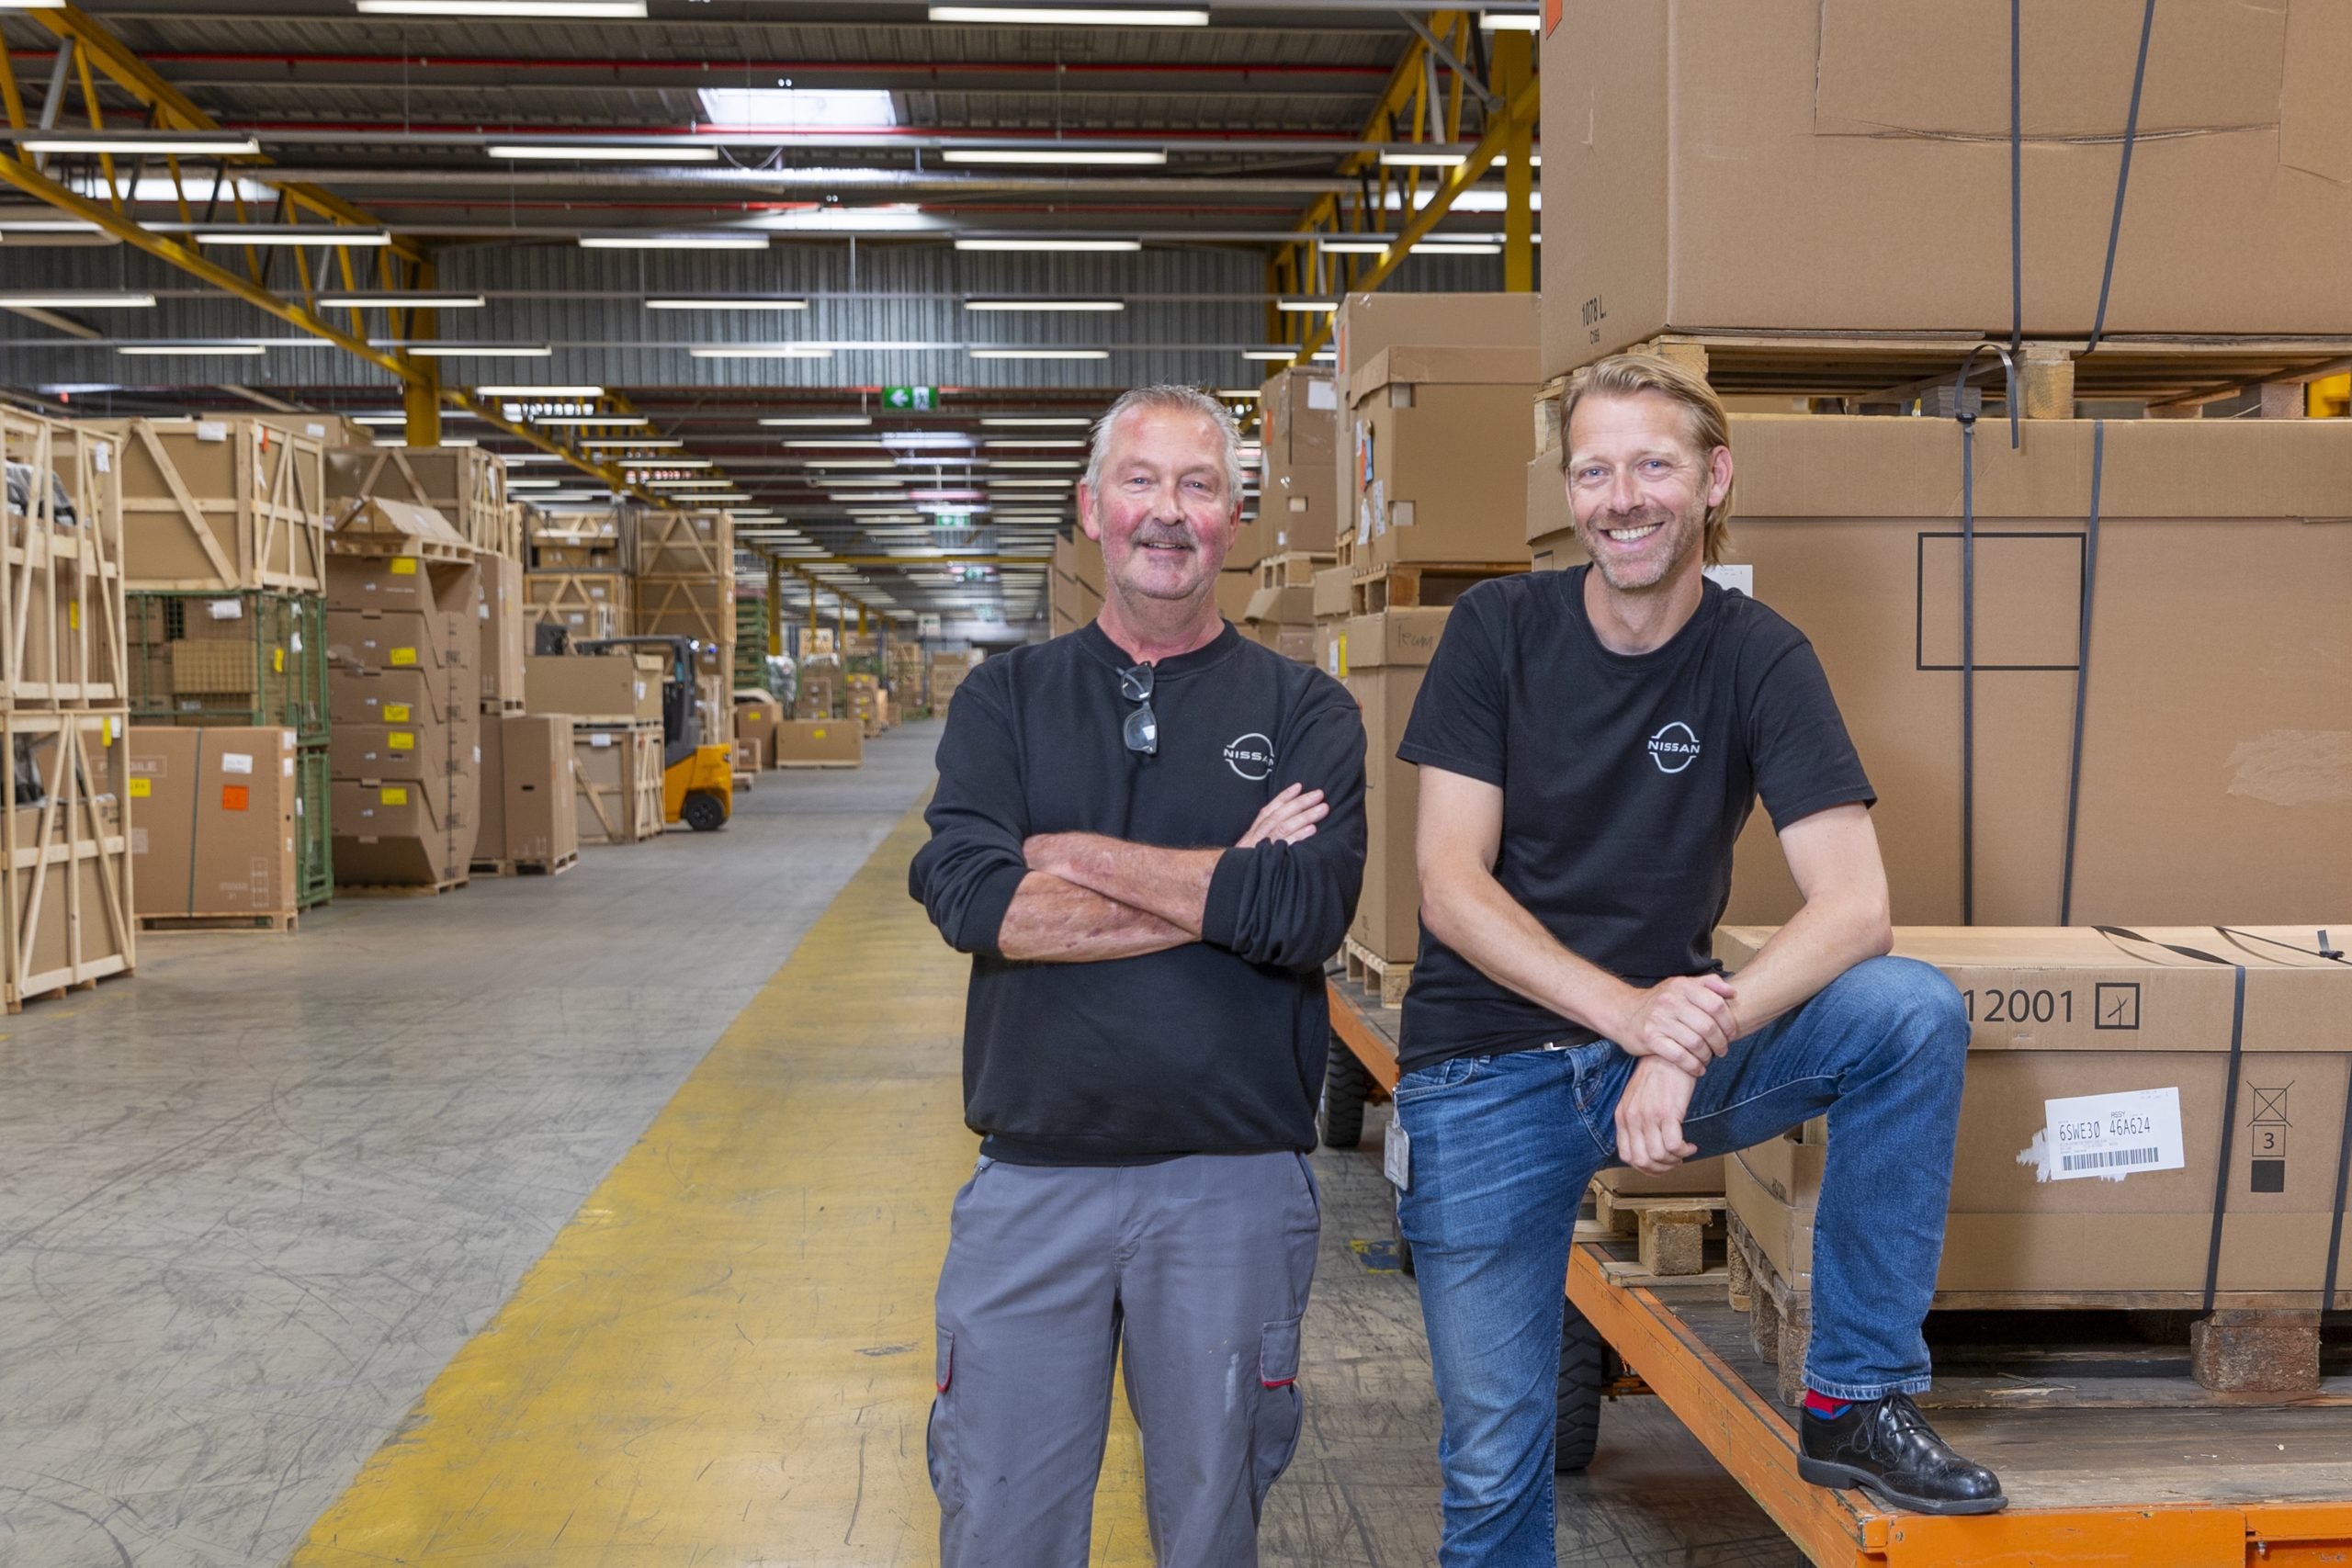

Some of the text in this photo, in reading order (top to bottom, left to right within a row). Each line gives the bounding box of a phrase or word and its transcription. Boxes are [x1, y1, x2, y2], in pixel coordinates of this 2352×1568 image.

[1582, 298, 1598, 328] 1078
[1648, 740, 1701, 754] NISSAN
[1962, 989, 2072, 1022] 12001
[2109, 1116, 2151, 1136] 46A624
[2263, 1132, 2275, 1150] 3
